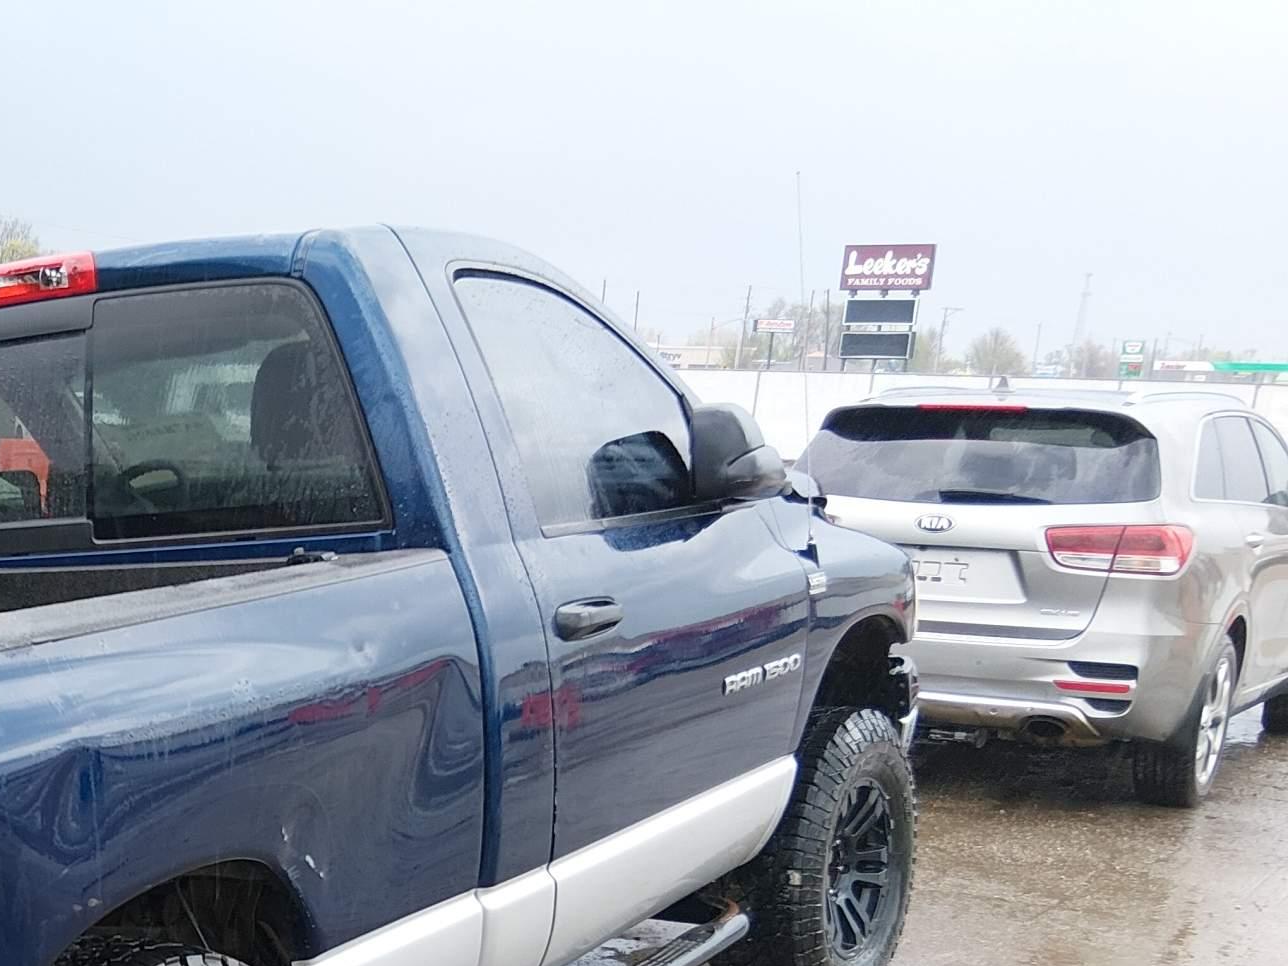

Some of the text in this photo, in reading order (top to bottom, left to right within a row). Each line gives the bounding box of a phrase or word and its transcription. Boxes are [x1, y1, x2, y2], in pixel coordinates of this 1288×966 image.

[844, 250, 930, 275] Leeker's
[847, 278, 923, 286] FAMILY FOODS
[919, 515, 952, 530] KIA
[722, 653, 801, 696] RAM 1500
